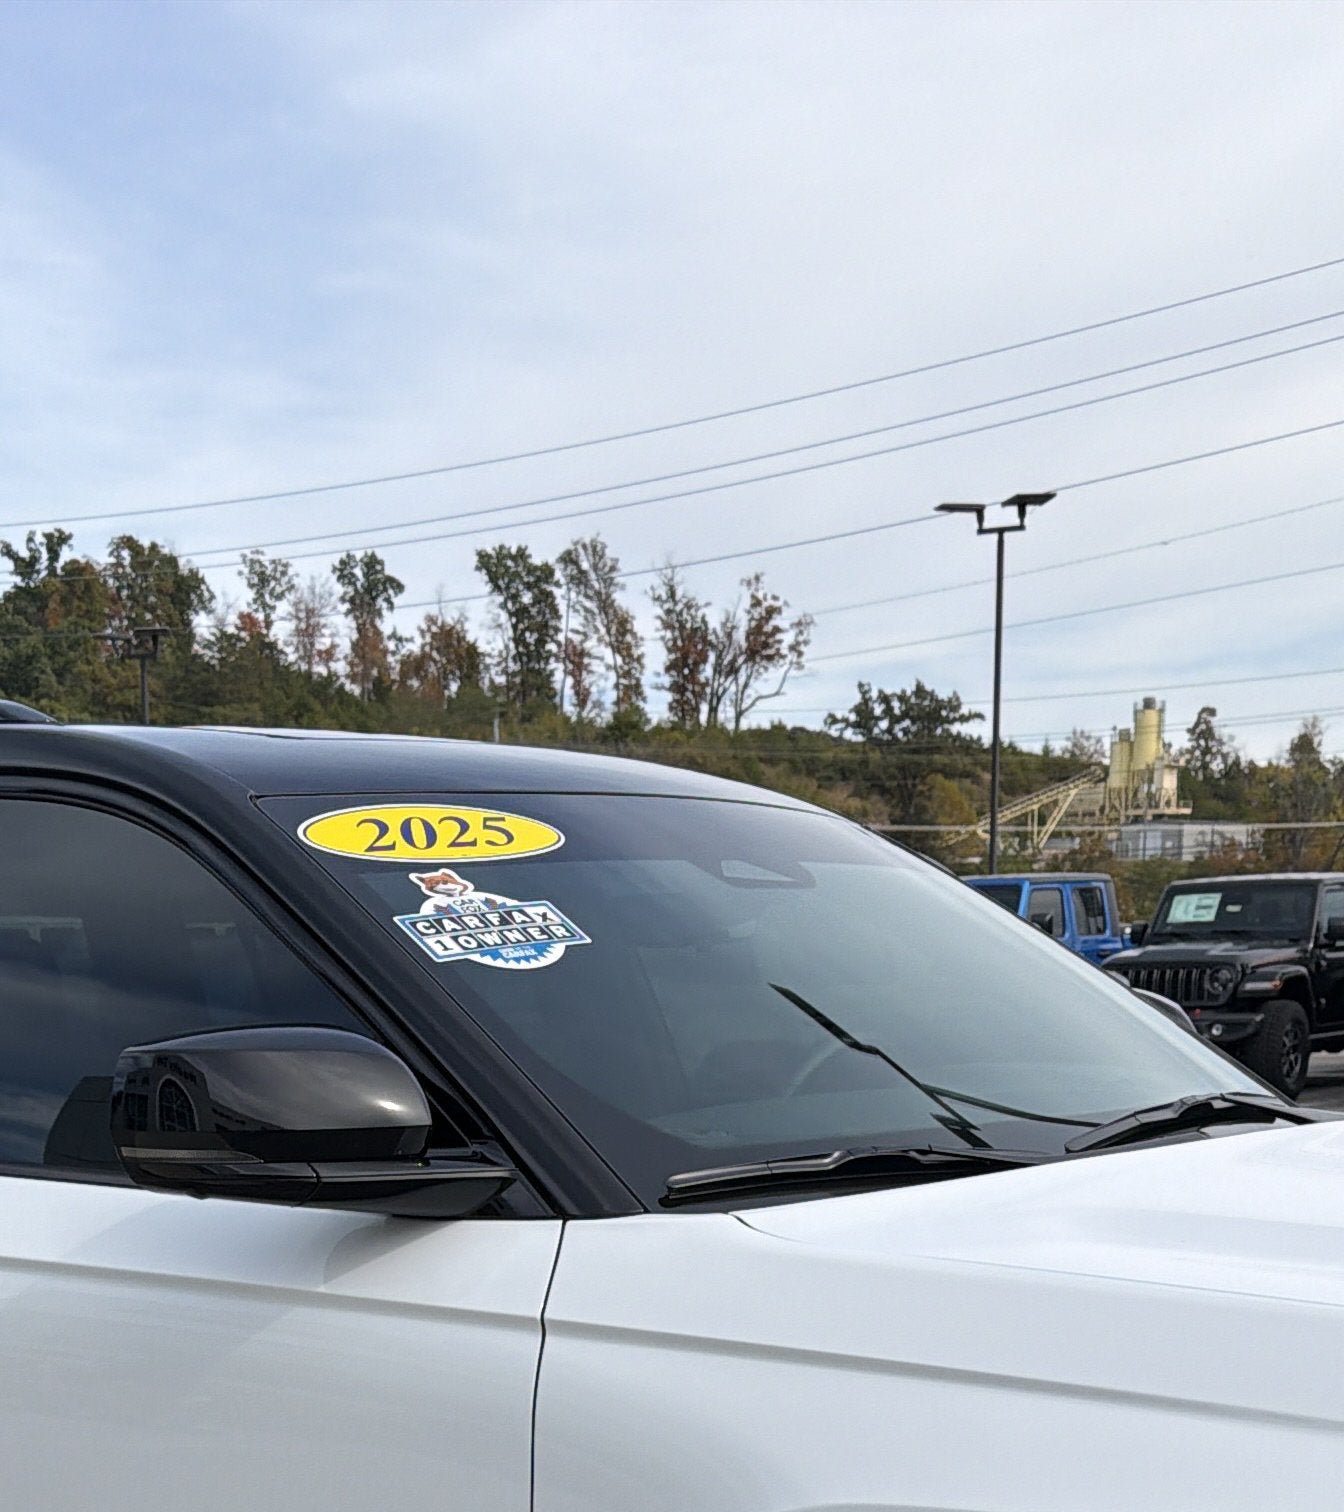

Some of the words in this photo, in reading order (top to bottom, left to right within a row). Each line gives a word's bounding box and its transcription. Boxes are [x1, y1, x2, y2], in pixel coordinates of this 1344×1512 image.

[356, 815, 515, 853] 2025
[415, 911, 555, 935] CARFAX
[433, 937, 454, 952] 1
[457, 926, 572, 949] OWNER
